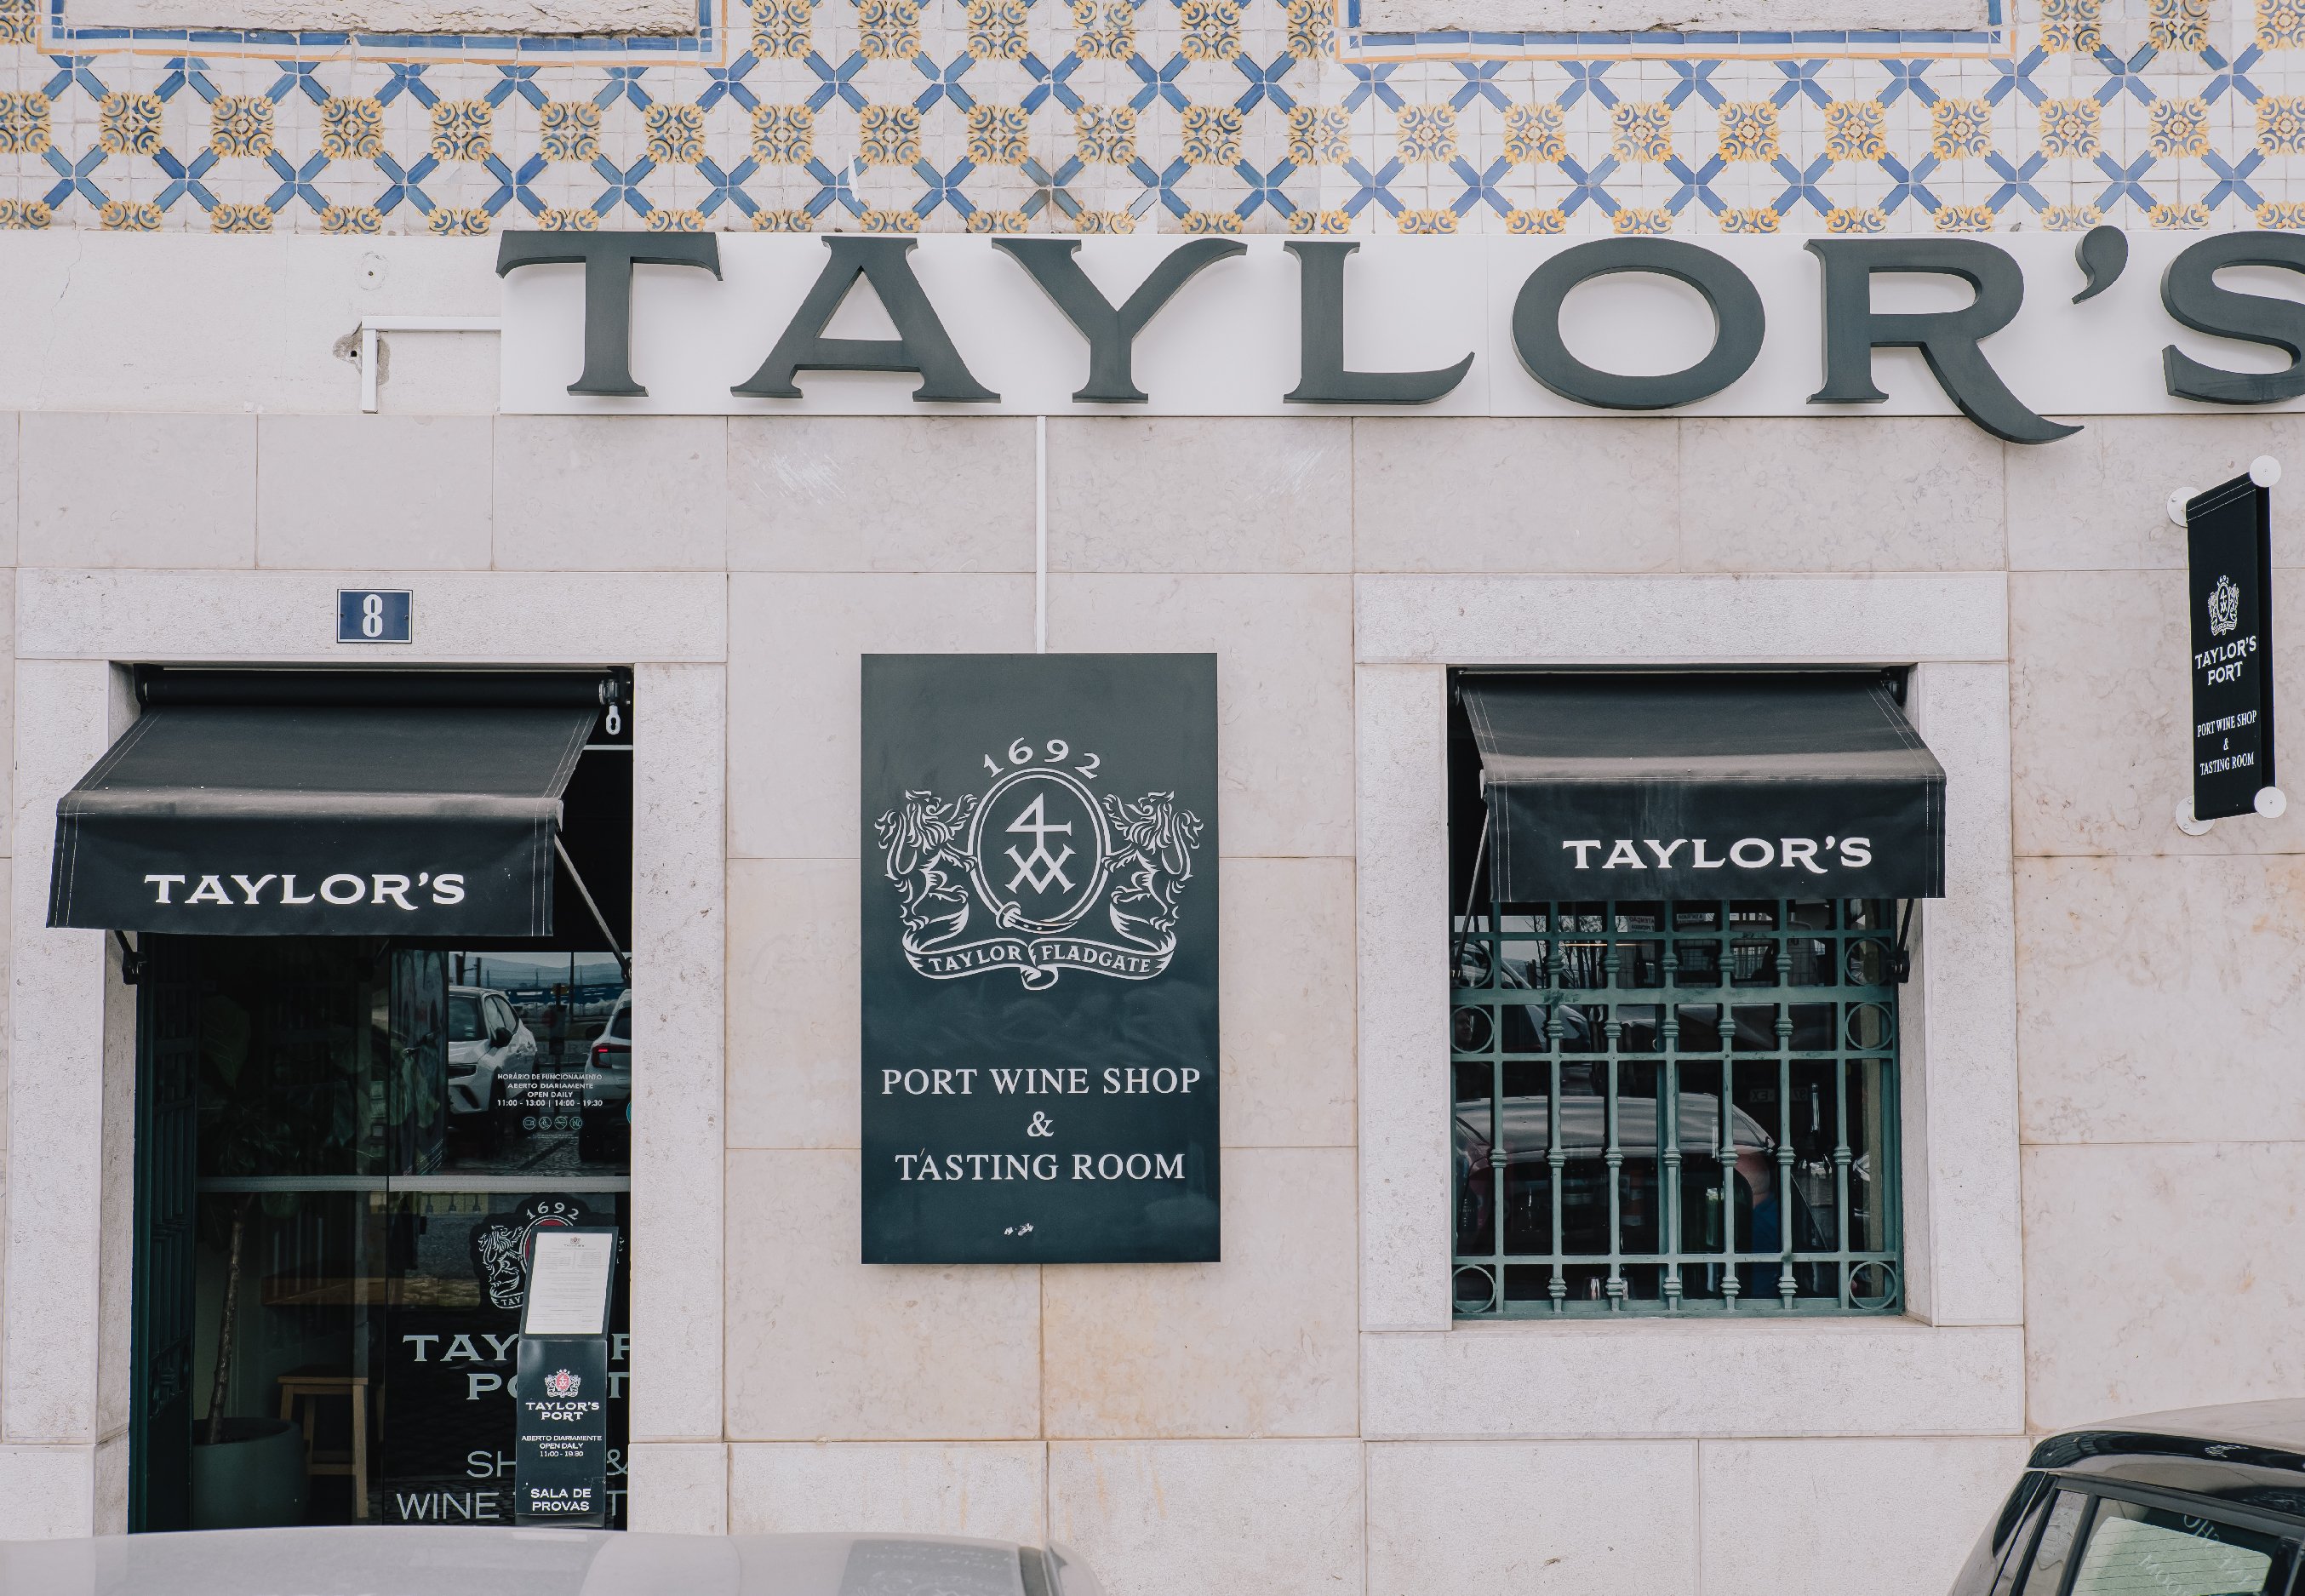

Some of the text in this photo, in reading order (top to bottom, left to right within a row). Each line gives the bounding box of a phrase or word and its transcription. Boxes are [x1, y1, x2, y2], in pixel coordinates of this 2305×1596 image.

[495, 225, 2305, 446] TAYLOR'S
[362, 594, 383, 638] 8
[2194, 635, 2256, 669] TAYLOR'S
[2207, 661, 2243, 686] PORT
[2197, 710, 2257, 738] PORT WINE SHOP
[983, 737, 1101, 779] 1692
[2223, 737, 2229, 751] &
[2199, 751, 2255, 775] TASTING ROOM
[1563, 836, 1873, 873] TAYLOR'S
[144, 872, 466, 910] TAYLOR'S
[929, 944, 1152, 974] TAYLOR FLADGATE
[497, 1072, 530, 1080] HORÁRIO
[882, 1067, 1201, 1095] PORT WINE SHOP
[1027, 1111, 1055, 1137] &
[895, 1153, 1186, 1181] TASTING ROOM
[526, 1201, 580, 1220] 1692
[525, 1401, 600, 1411] TAYLOR'S
[541, 1411, 584, 1422] PORT
[396, 1492, 500, 1520] WINE
[530, 1488, 592, 1499] SALA DE
[532, 1501, 590, 1512] PROVAS
